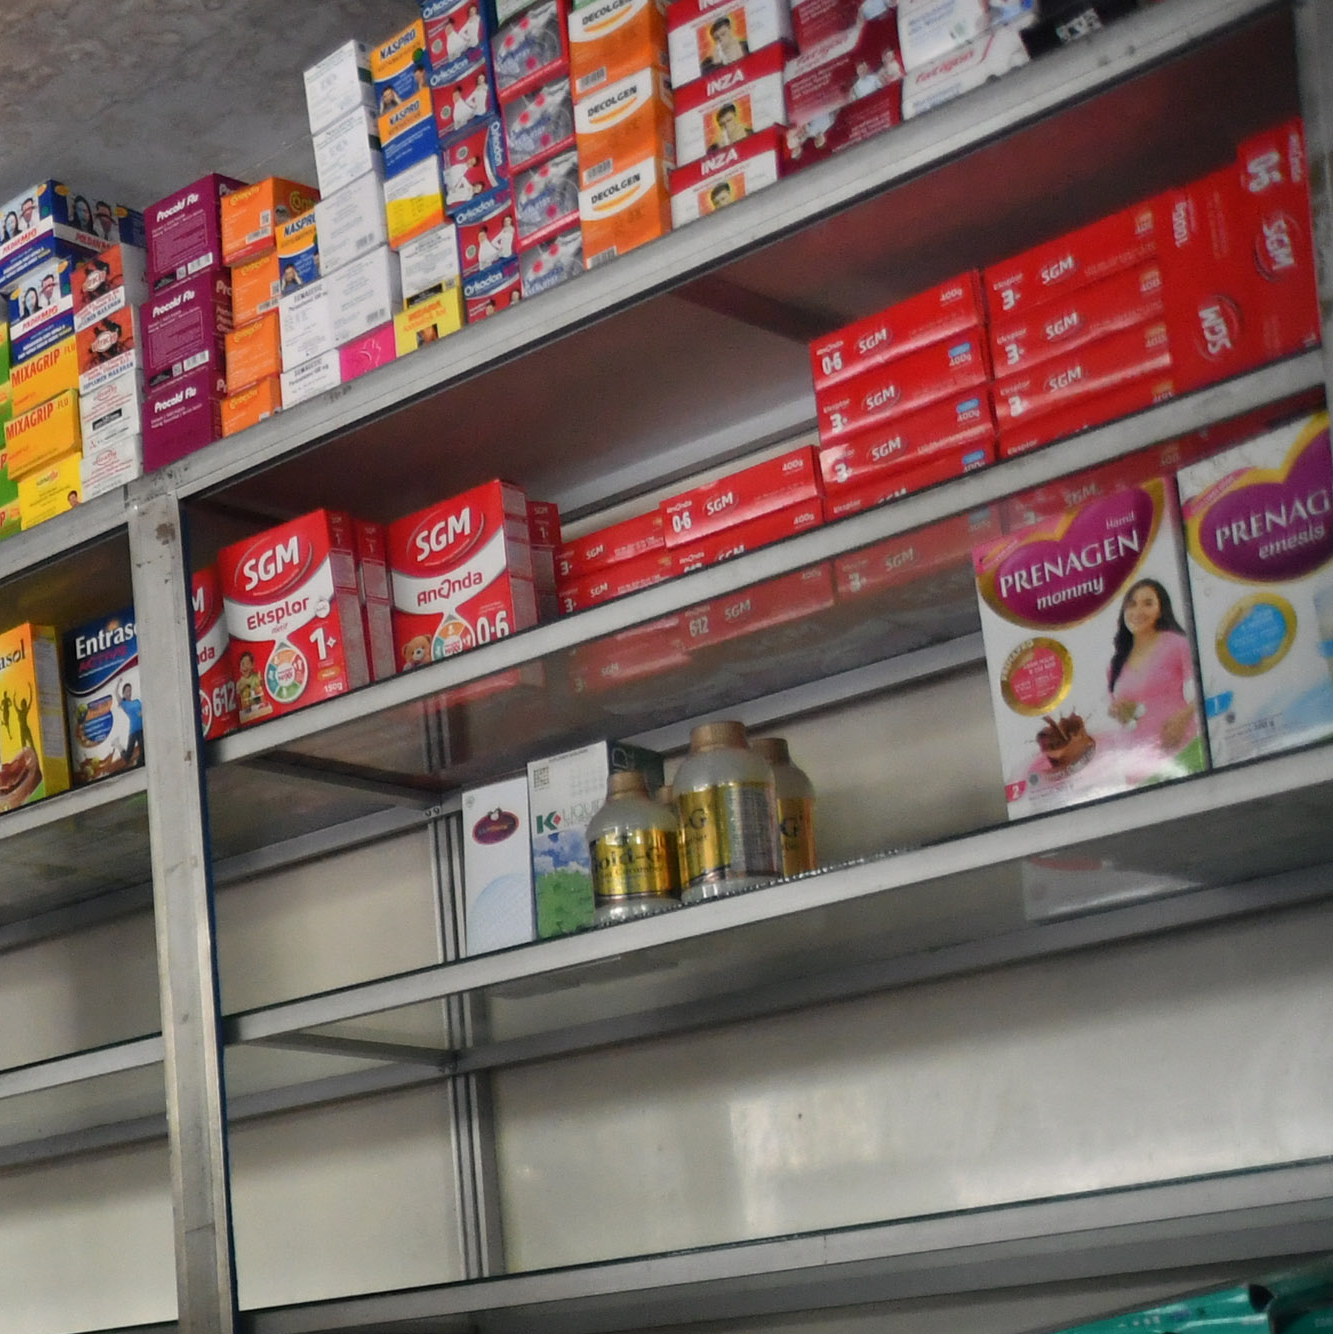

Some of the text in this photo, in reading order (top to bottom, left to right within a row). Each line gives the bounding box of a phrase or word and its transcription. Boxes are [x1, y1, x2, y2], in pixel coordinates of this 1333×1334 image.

[379, 29, 417, 62] NASPRO
[706, 69, 745, 97] INZA
[389, 99, 421, 126] NASPRO
[587, 85, 638, 118] DECOLGEN
[700, 149, 738, 176] INZA
[591, 173, 641, 206] DECOLGEN
[156, 192, 200, 222] Procold Flu
[1040, 256, 1074, 285] SGM
[152, 290, 195, 318] Procold Flu
[858, 328, 887, 354] SGM
[1045, 312, 1078, 341] SGM
[11, 348, 61, 387] MIXAGRIP
[1048, 366, 1082, 393] SGM
[154, 386, 197, 413] Procold Flu
[866, 385, 897, 411] SGM
[5, 402, 54, 440] MIXAGRIP
[871, 435, 902, 462] SGM
[706, 492, 734, 516] SGM
[416, 507, 472, 561] SGM
[1258, 525, 1325, 560] emesis
[243, 535, 301, 592] SGM
[999, 530, 1140, 599] PRENAGEN
[1036, 575, 1104, 611] mommy
[247, 596, 309, 630] Eksplor
